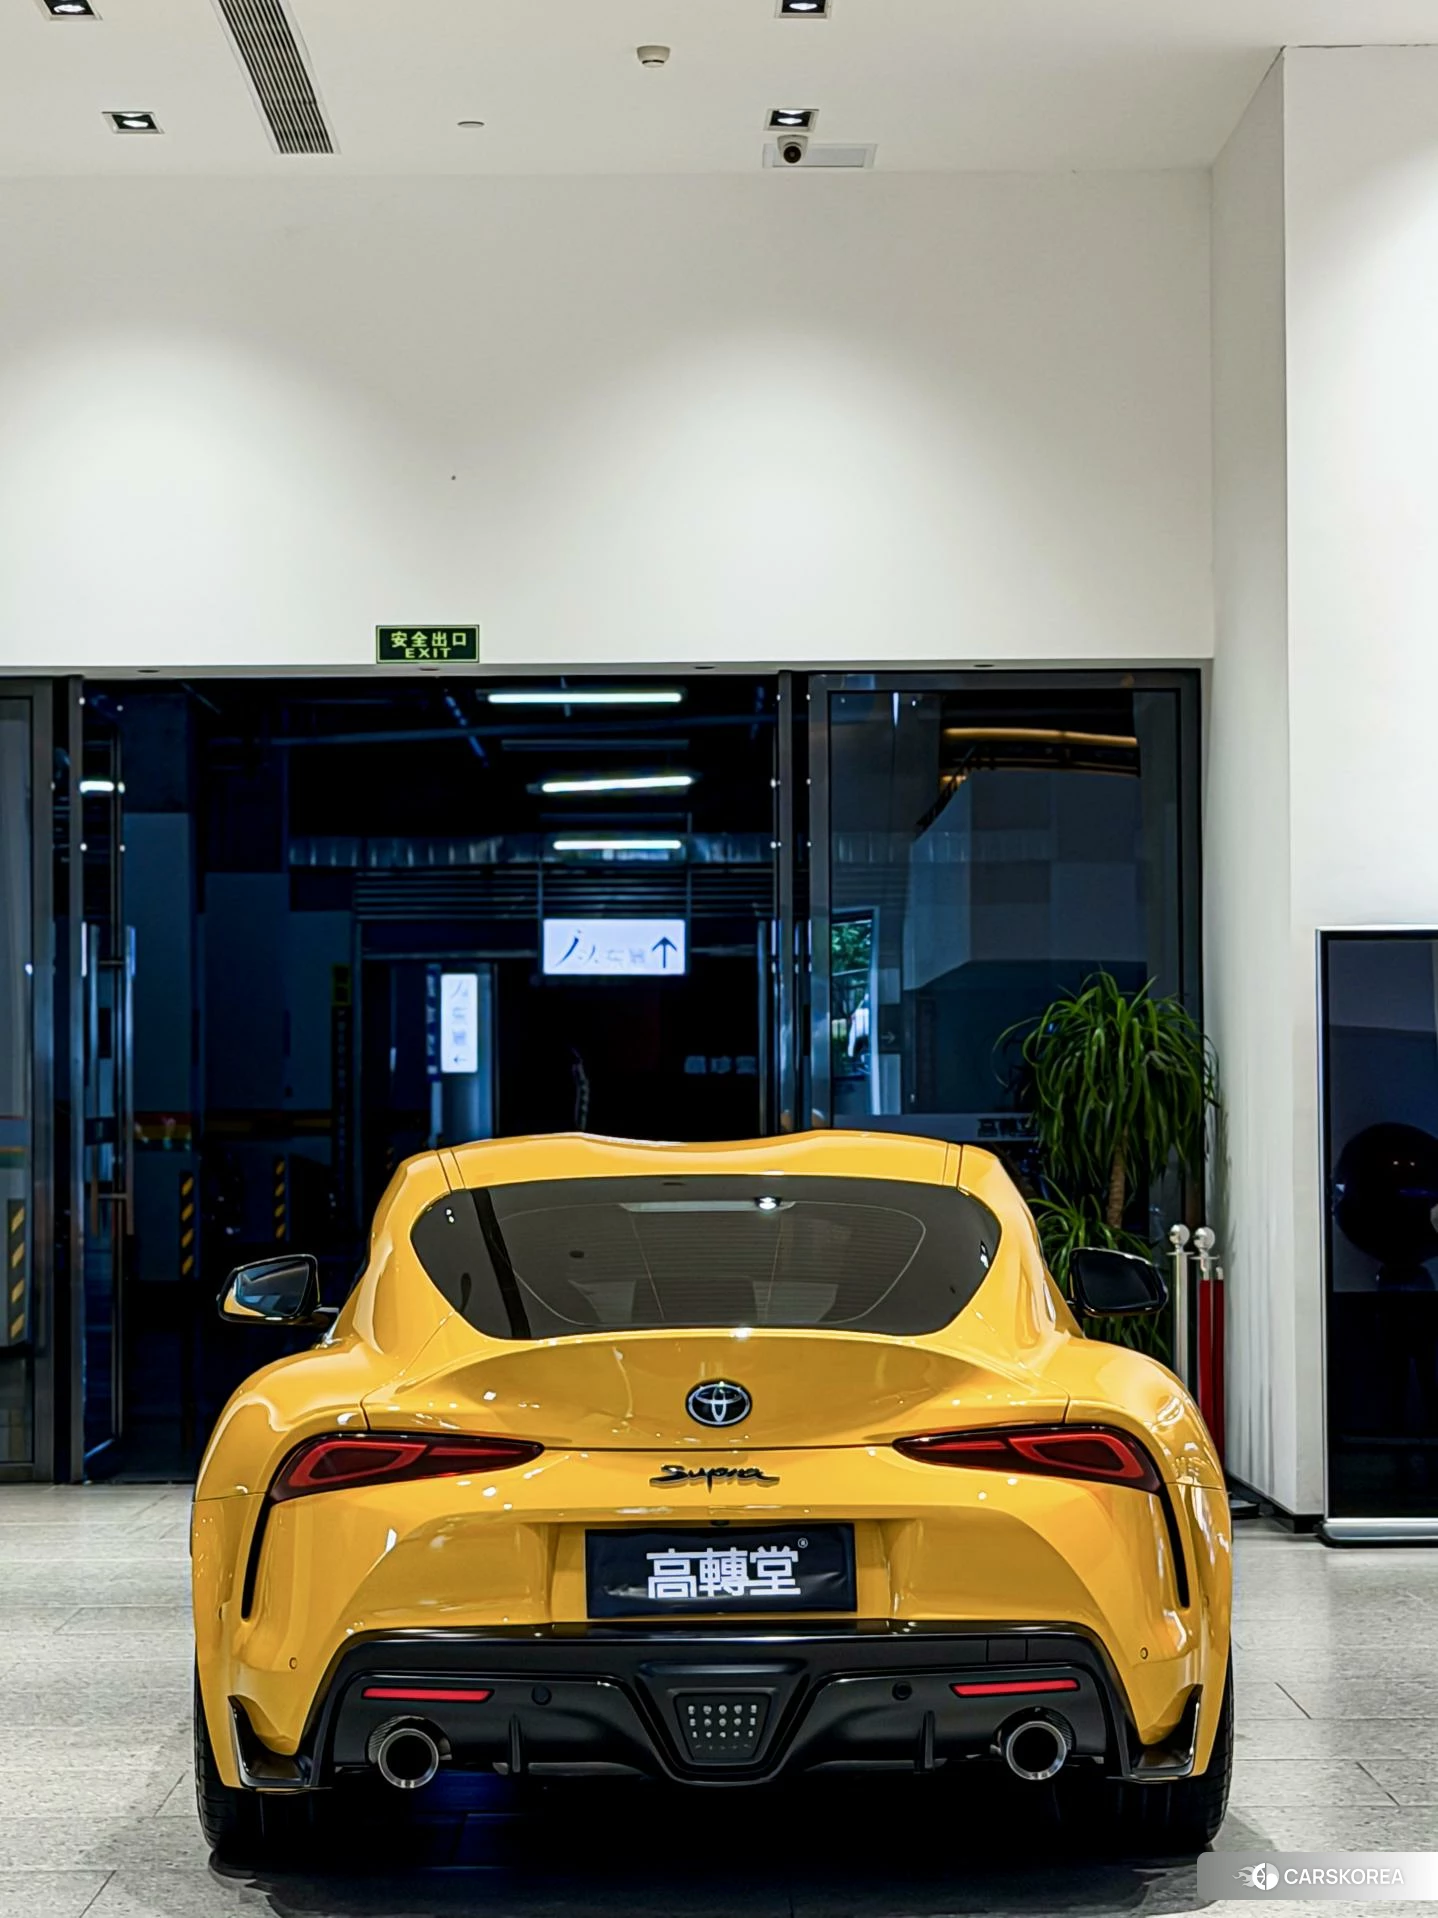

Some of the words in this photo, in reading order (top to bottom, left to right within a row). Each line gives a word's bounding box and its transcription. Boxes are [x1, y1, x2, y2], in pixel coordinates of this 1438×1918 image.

[390, 631, 467, 648] 安全出口
[404, 647, 452, 659] EXIT
[649, 1464, 781, 1494] Supra
[646, 1546, 801, 1599] 高轉堂
